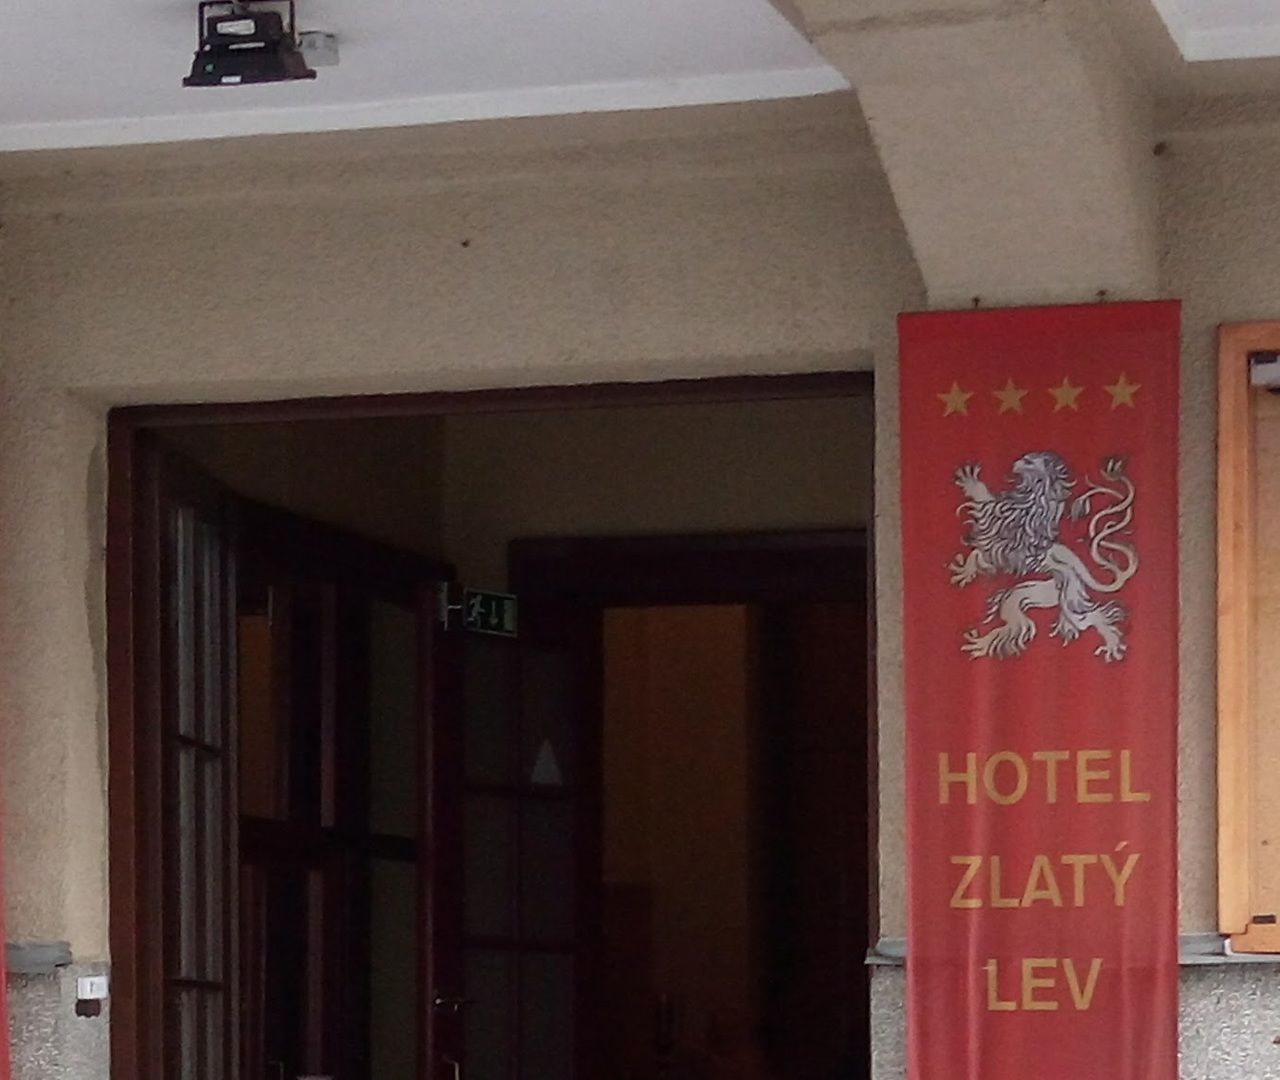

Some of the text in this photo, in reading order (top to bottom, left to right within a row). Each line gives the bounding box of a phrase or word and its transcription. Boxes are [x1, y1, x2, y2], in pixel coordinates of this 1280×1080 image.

[938, 750, 1151, 804] HOTEL
[950, 841, 1140, 908] ZLATÝ
[984, 957, 1104, 1012] LEV
